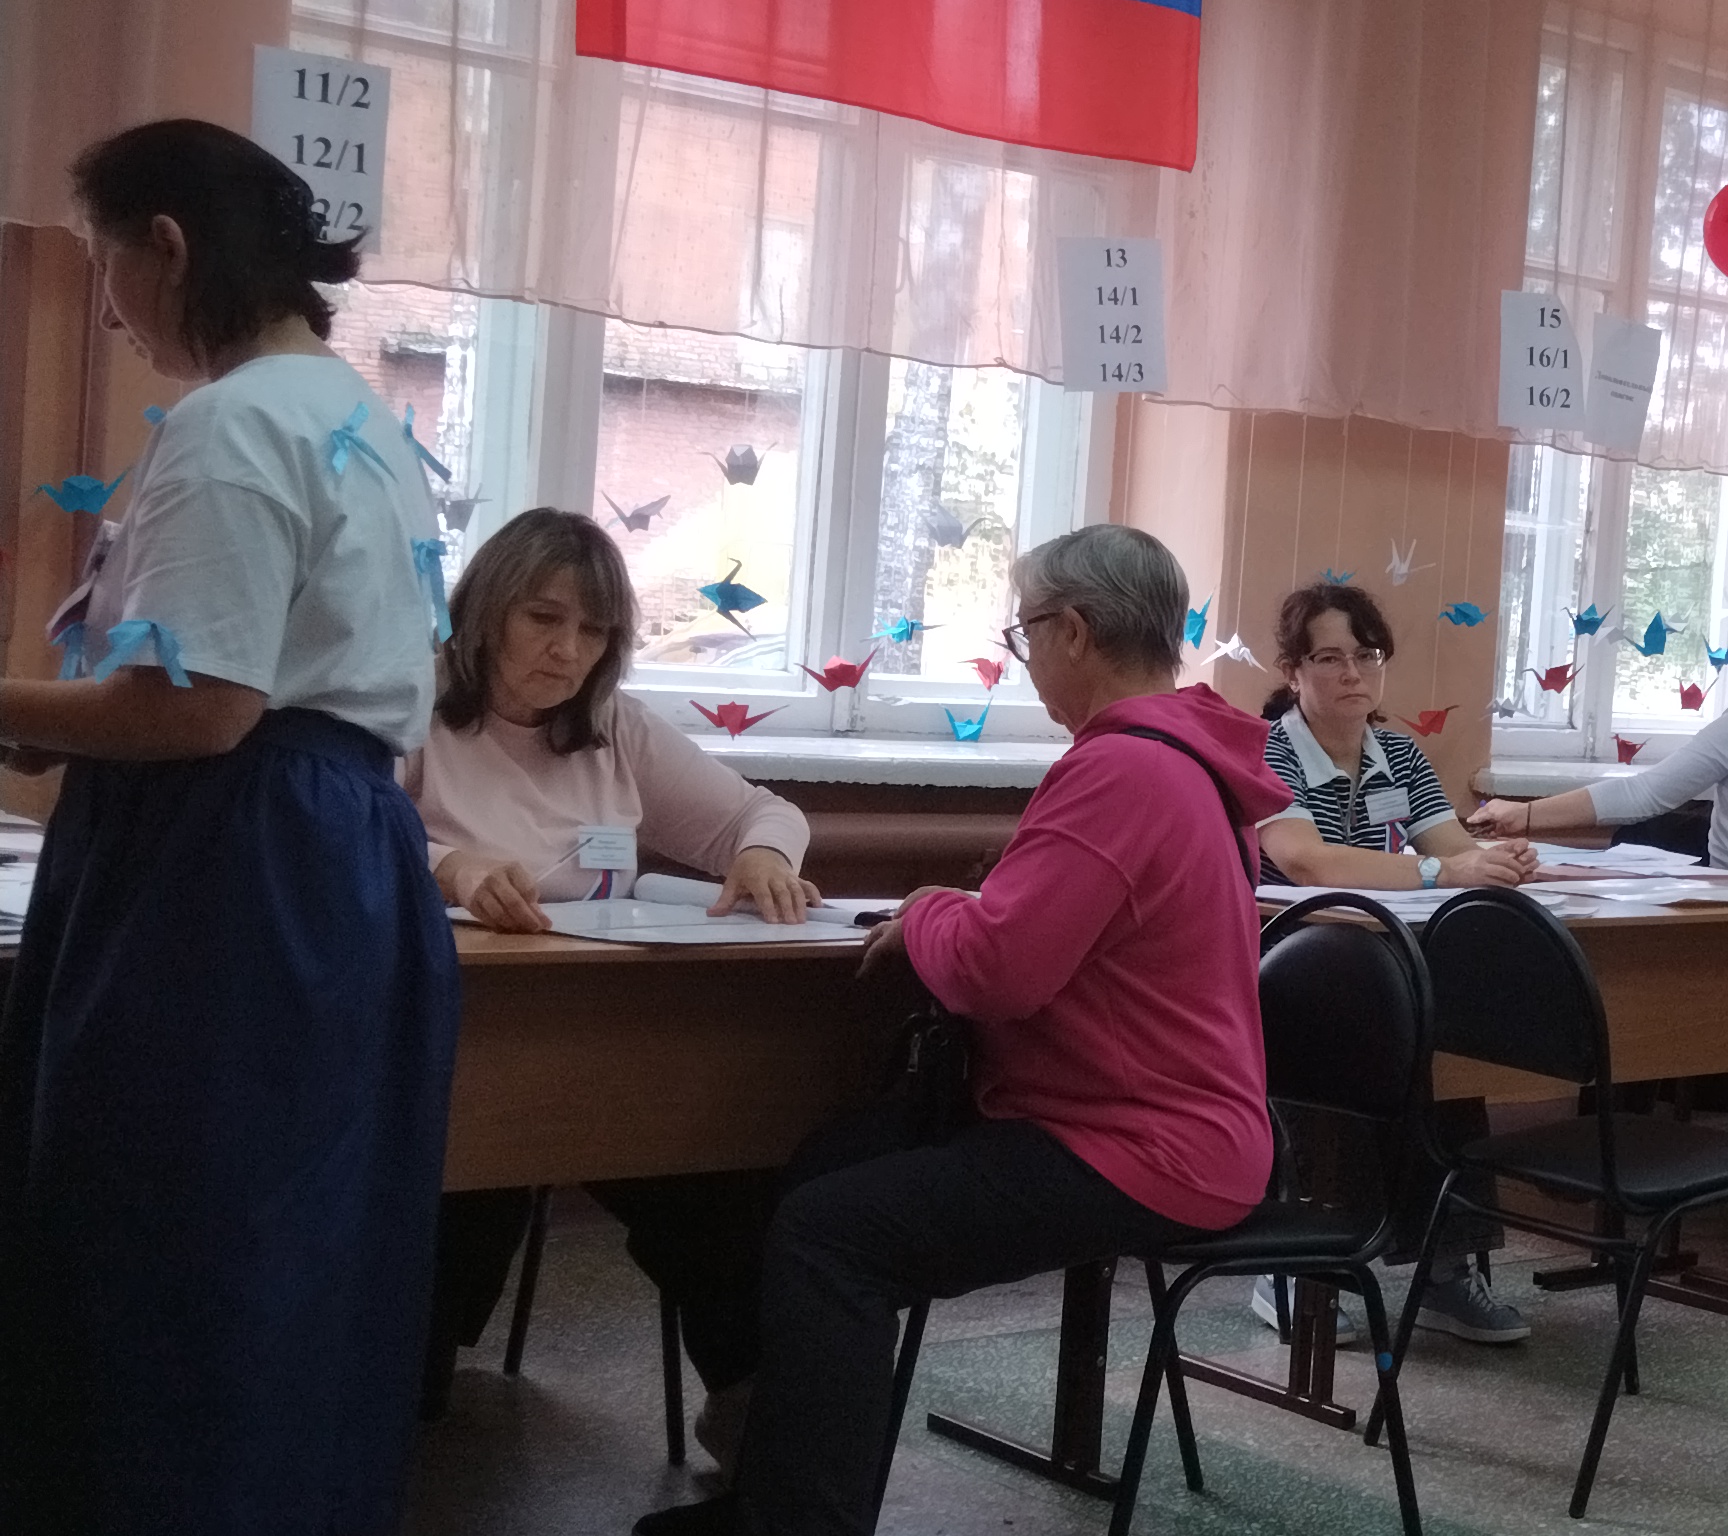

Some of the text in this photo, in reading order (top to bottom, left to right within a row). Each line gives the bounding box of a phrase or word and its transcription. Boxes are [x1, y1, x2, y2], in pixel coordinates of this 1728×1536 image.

[293, 68, 371, 109] 11/2
[292, 134, 368, 175] 12/1
[310, 197, 365, 231] 2/2
[1103, 248, 1128, 268] 13
[1096, 285, 1139, 306] 14/1
[1538, 307, 1562, 329] 15
[1098, 324, 1143, 345] 14/2
[1526, 346, 1570, 369] 16/1
[1100, 362, 1144, 383] 14/3
[1526, 386, 1571, 409] 16/2
